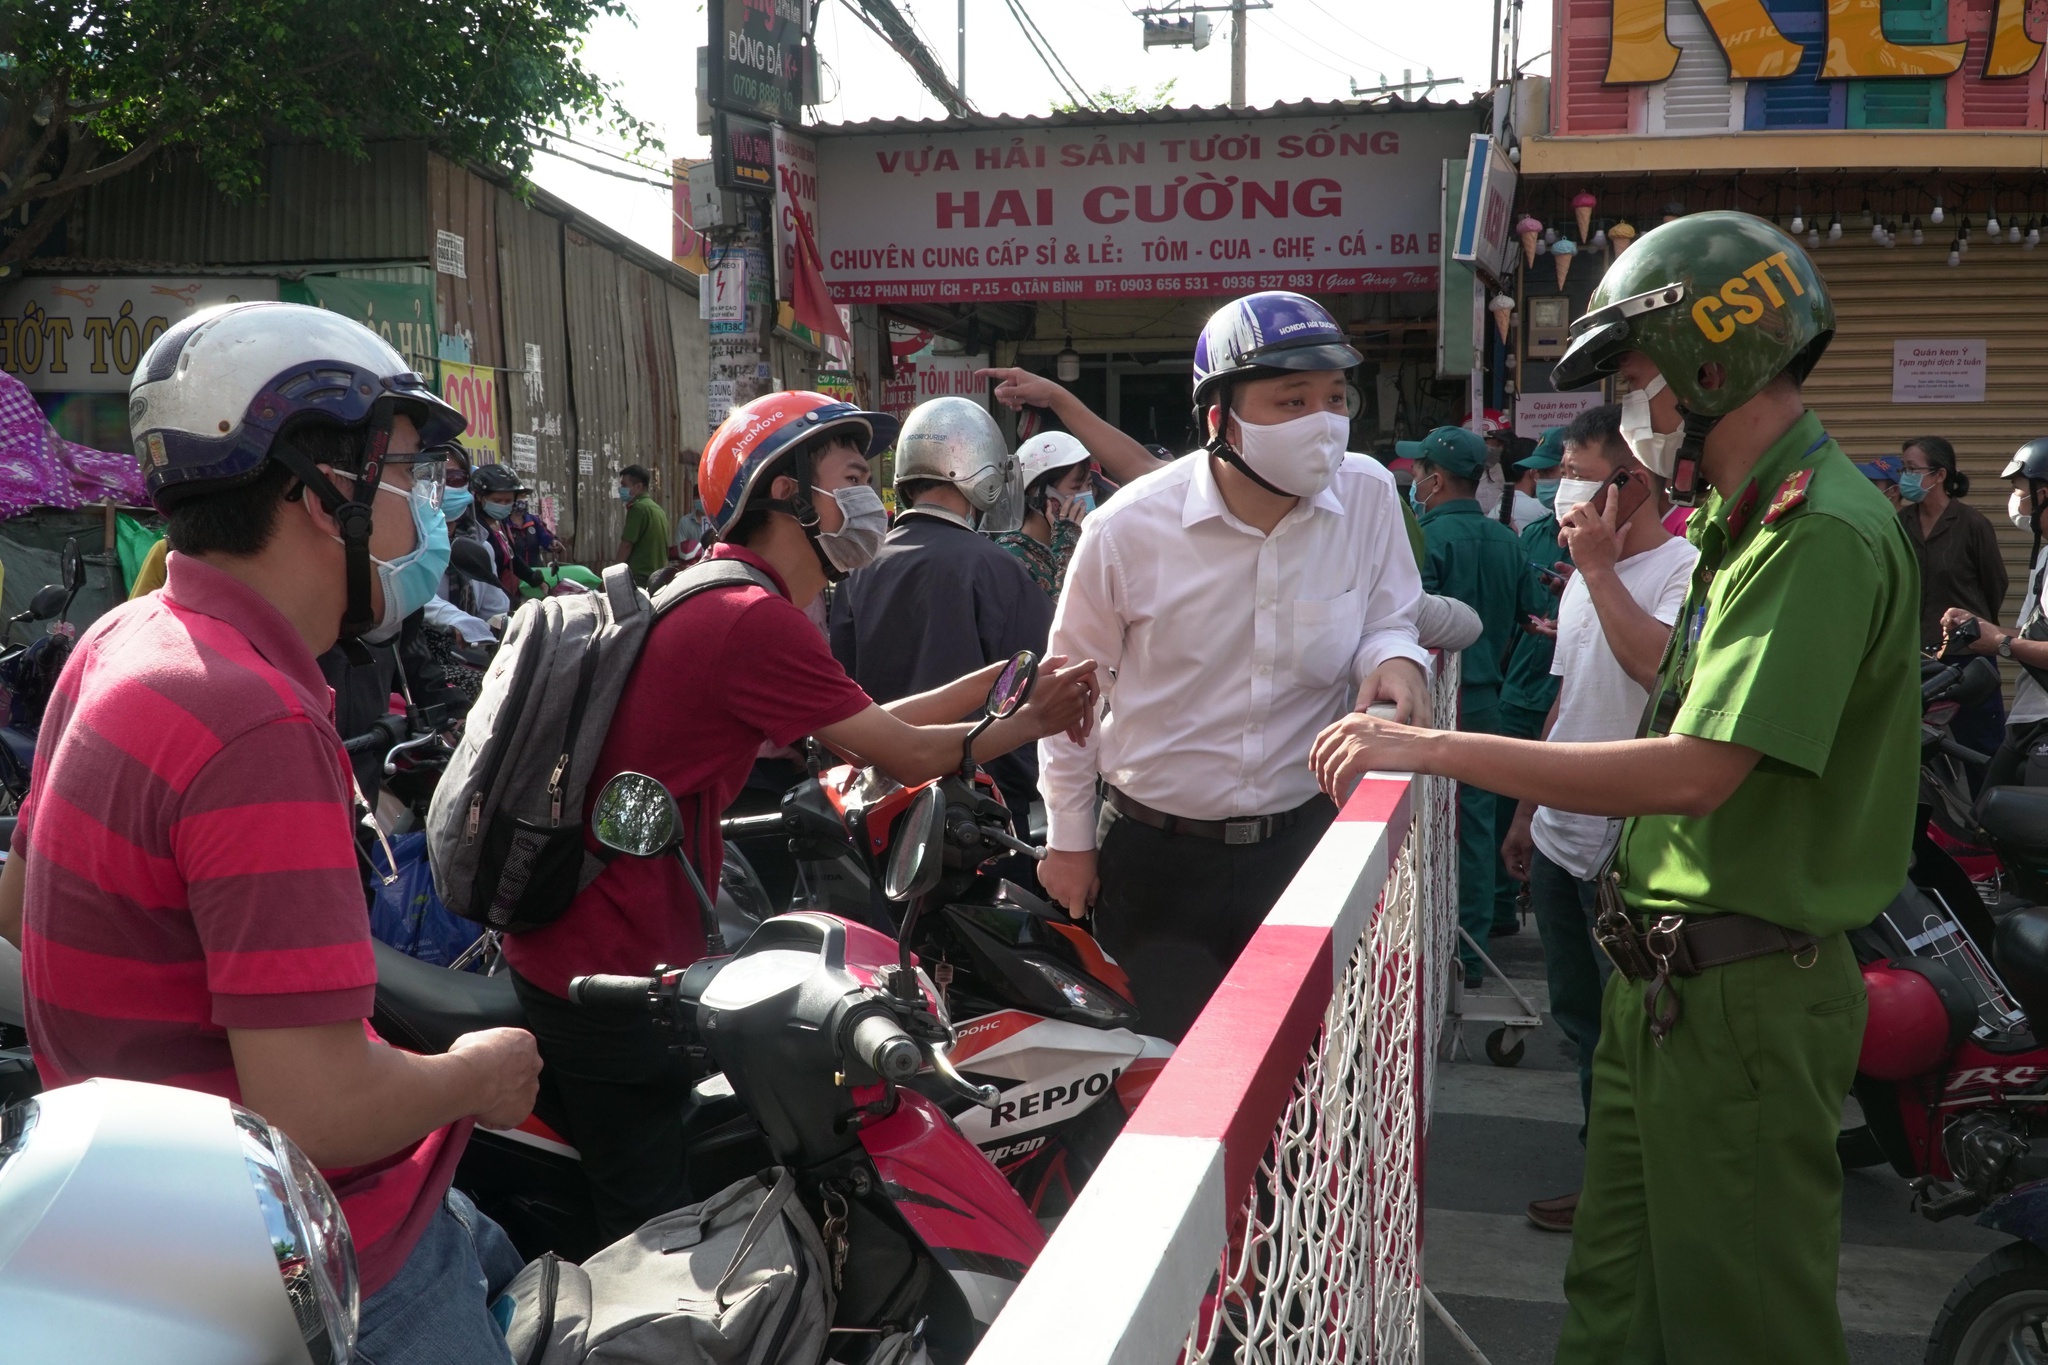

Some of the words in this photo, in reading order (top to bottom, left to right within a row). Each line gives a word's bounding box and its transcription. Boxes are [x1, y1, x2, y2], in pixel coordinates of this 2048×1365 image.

[729, 28, 765, 71] BÓNG
[766, 43, 783, 78] ĐÁ
[784, 52, 798, 81] K+
[733, 74, 757, 101] 0706
[758, 81, 781, 108] 8888
[876, 145, 960, 177] VỰA
[975, 137, 1046, 170] HẢI
[1060, 134, 1146, 168] SẢN
[1160, 133, 1261, 163] TƯƠI
[1277, 124, 1399, 159] SỐNG
[936, 188, 1054, 229] HAI
[1083, 172, 1342, 225] CƯỜNG
[830, 243, 915, 270] CHUYÊN
[922, 246, 979, 268] CUNG
[986, 237, 1029, 267] CẤP
[1036, 237, 1057, 265] SỈ
[1064, 243, 1080, 265] &
[1088, 235, 1123, 264] LẺ:
[1141, 236, 1188, 262] TÔM
[1209, 239, 1252, 260] CUA
[1273, 236, 1315, 262] GHẸ
[1338, 229, 1367, 257] CÁ
[1391, 233, 1419, 255] BA
[849, 284, 872, 297] 142
[875, 283, 908, 297] PHAN
[911, 283, 936, 296] HUY
[940, 281, 960, 296] ÍCH
[972, 282, 1000, 295] P.15
[1011, 278, 1049, 296] Q.TÂN
[1052, 277, 1083, 294] BÌNH
[1095, 279, 1116, 293] ĐT:
[1120, 278, 1152, 292] 0903
[1156, 277, 1181, 291] 656
[1185, 276, 1209, 290] 531
[1222, 275, 1255, 289] 0936
[1259, 275, 1284, 288] 527
[1288, 274, 1313, 287] 983
[1361, 272, 1398, 288] Hàng
[1402, 271, 1429, 287] Tận
[1691, 251, 1805, 343] CSTT
[398, 299, 435, 381] HẢI
[1279, 322, 1307, 336] HONDA
[1898, 359, 1915, 368] Tạm
[1937, 358, 1955, 368] dịch
[1963, 356, 1981, 366] tuần
[1913, 347, 1937, 357] Quán
[1940, 348, 1959, 356] kem
[919, 364, 950, 395] TÔM
[954, 363, 986, 394] HÙM
[445, 366, 496, 440] CƠM
[1520, 412, 1536, 421] Tạm
[1557, 412, 1574, 421] dịch
[1533, 400, 1557, 410] Quán
[1559, 401, 1578, 410] kem
[731, 410, 784, 458] AhaMove
[957, 1020, 1001, 1039] DOHC
[984, 1136, 1046, 1164] ap-on
